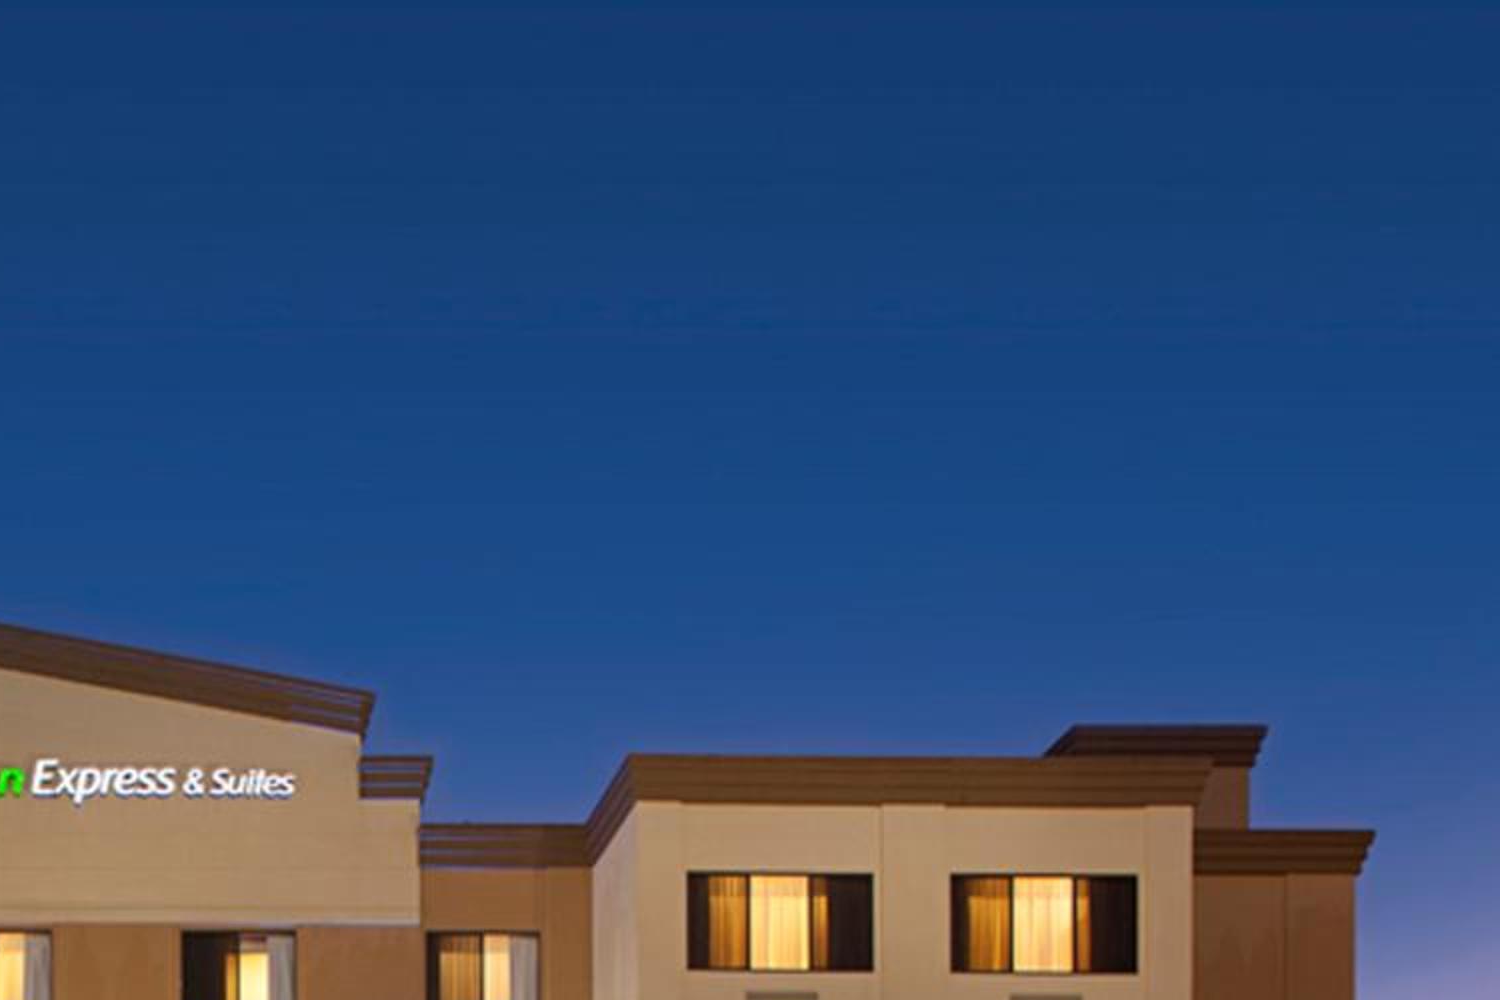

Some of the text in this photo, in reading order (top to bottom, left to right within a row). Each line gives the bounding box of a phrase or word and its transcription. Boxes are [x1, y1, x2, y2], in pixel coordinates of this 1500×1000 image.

[31, 759, 176, 803] Express
[182, 769, 204, 795] &
[211, 768, 297, 797] Suites
